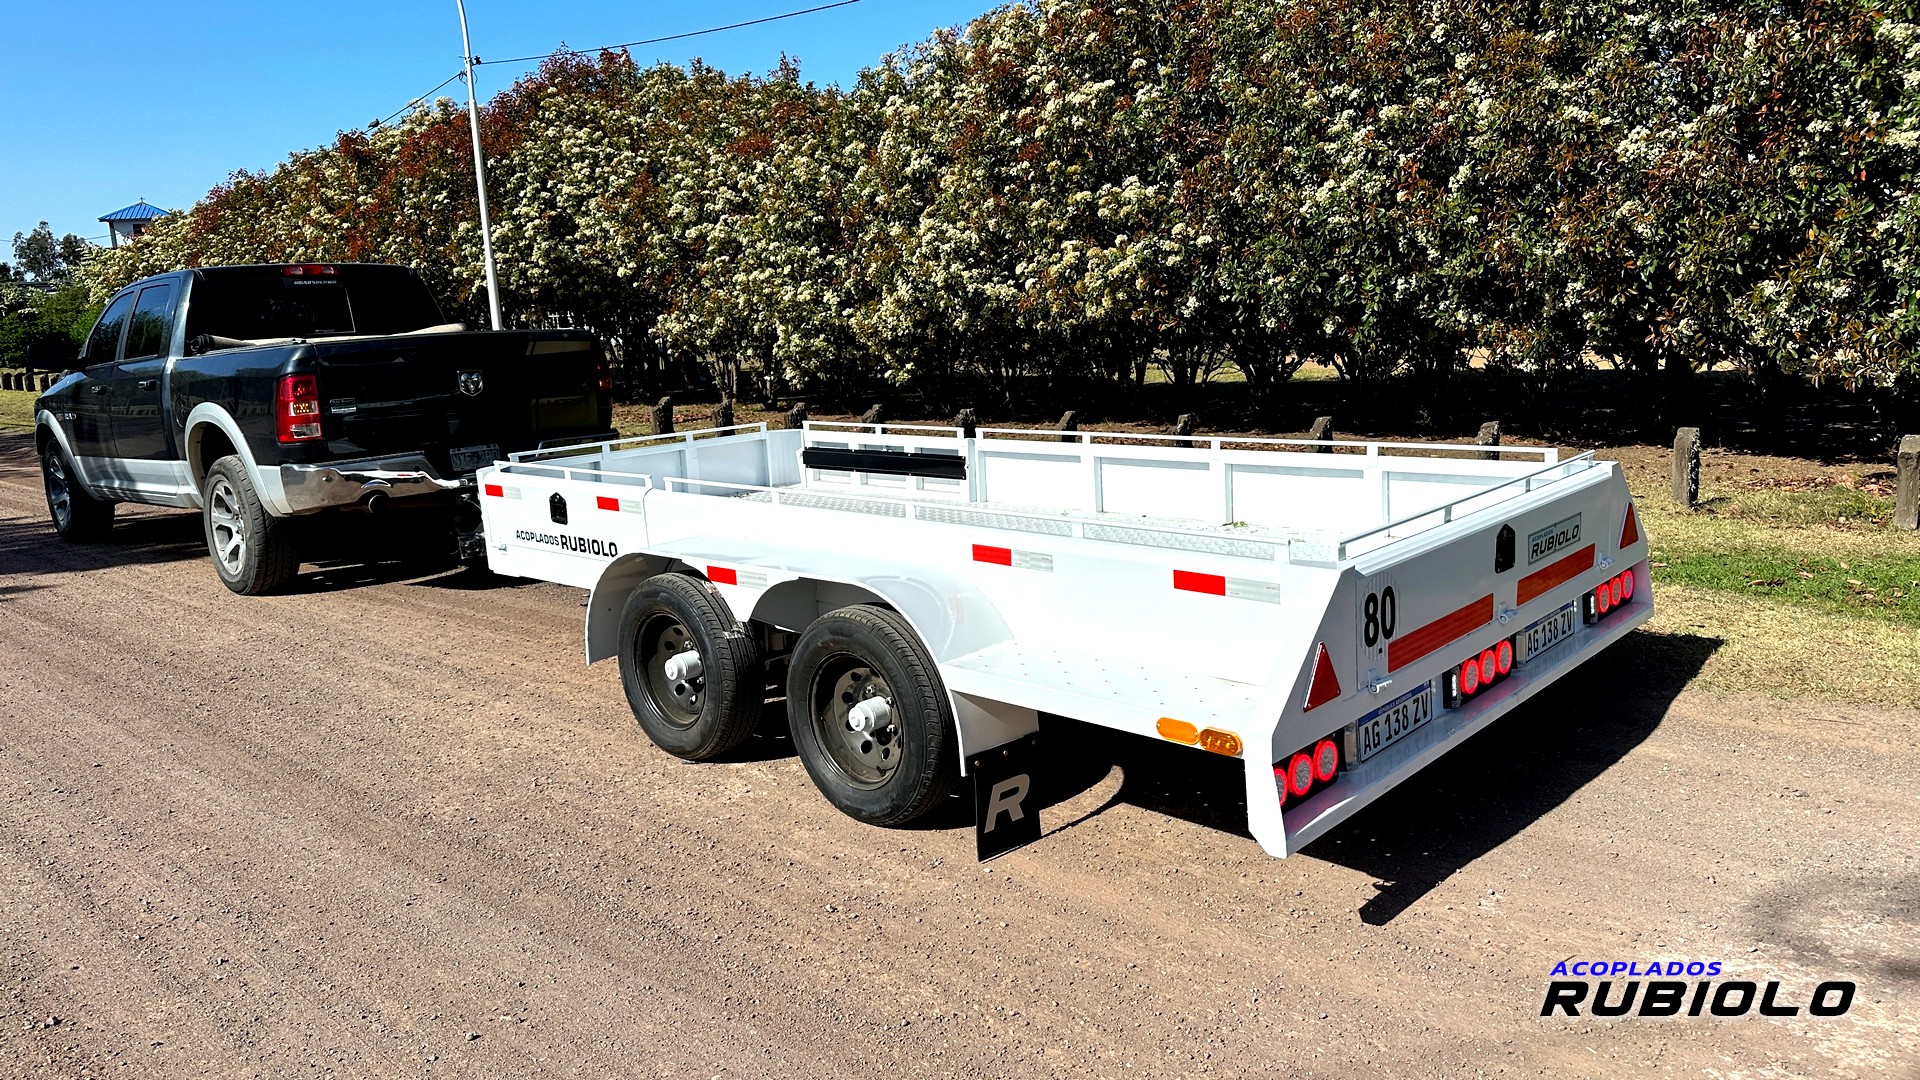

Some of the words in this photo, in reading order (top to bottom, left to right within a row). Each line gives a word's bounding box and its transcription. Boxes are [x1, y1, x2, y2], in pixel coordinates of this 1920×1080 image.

[516, 529, 559, 546] ACOPLADOS
[560, 534, 618, 557] RUBIOLO
[1531, 524, 1580, 559] RUBIOLO
[1364, 586, 1395, 648] 80
[1527, 629, 1539, 657] AG
[1541, 617, 1559, 648] 138
[1561, 609, 1572, 636] ZV
[1364, 720, 1381, 755] AG
[1385, 704, 1409, 742] 138
[1413, 692, 1428, 725] ZV
[984, 773, 1030, 834] R
